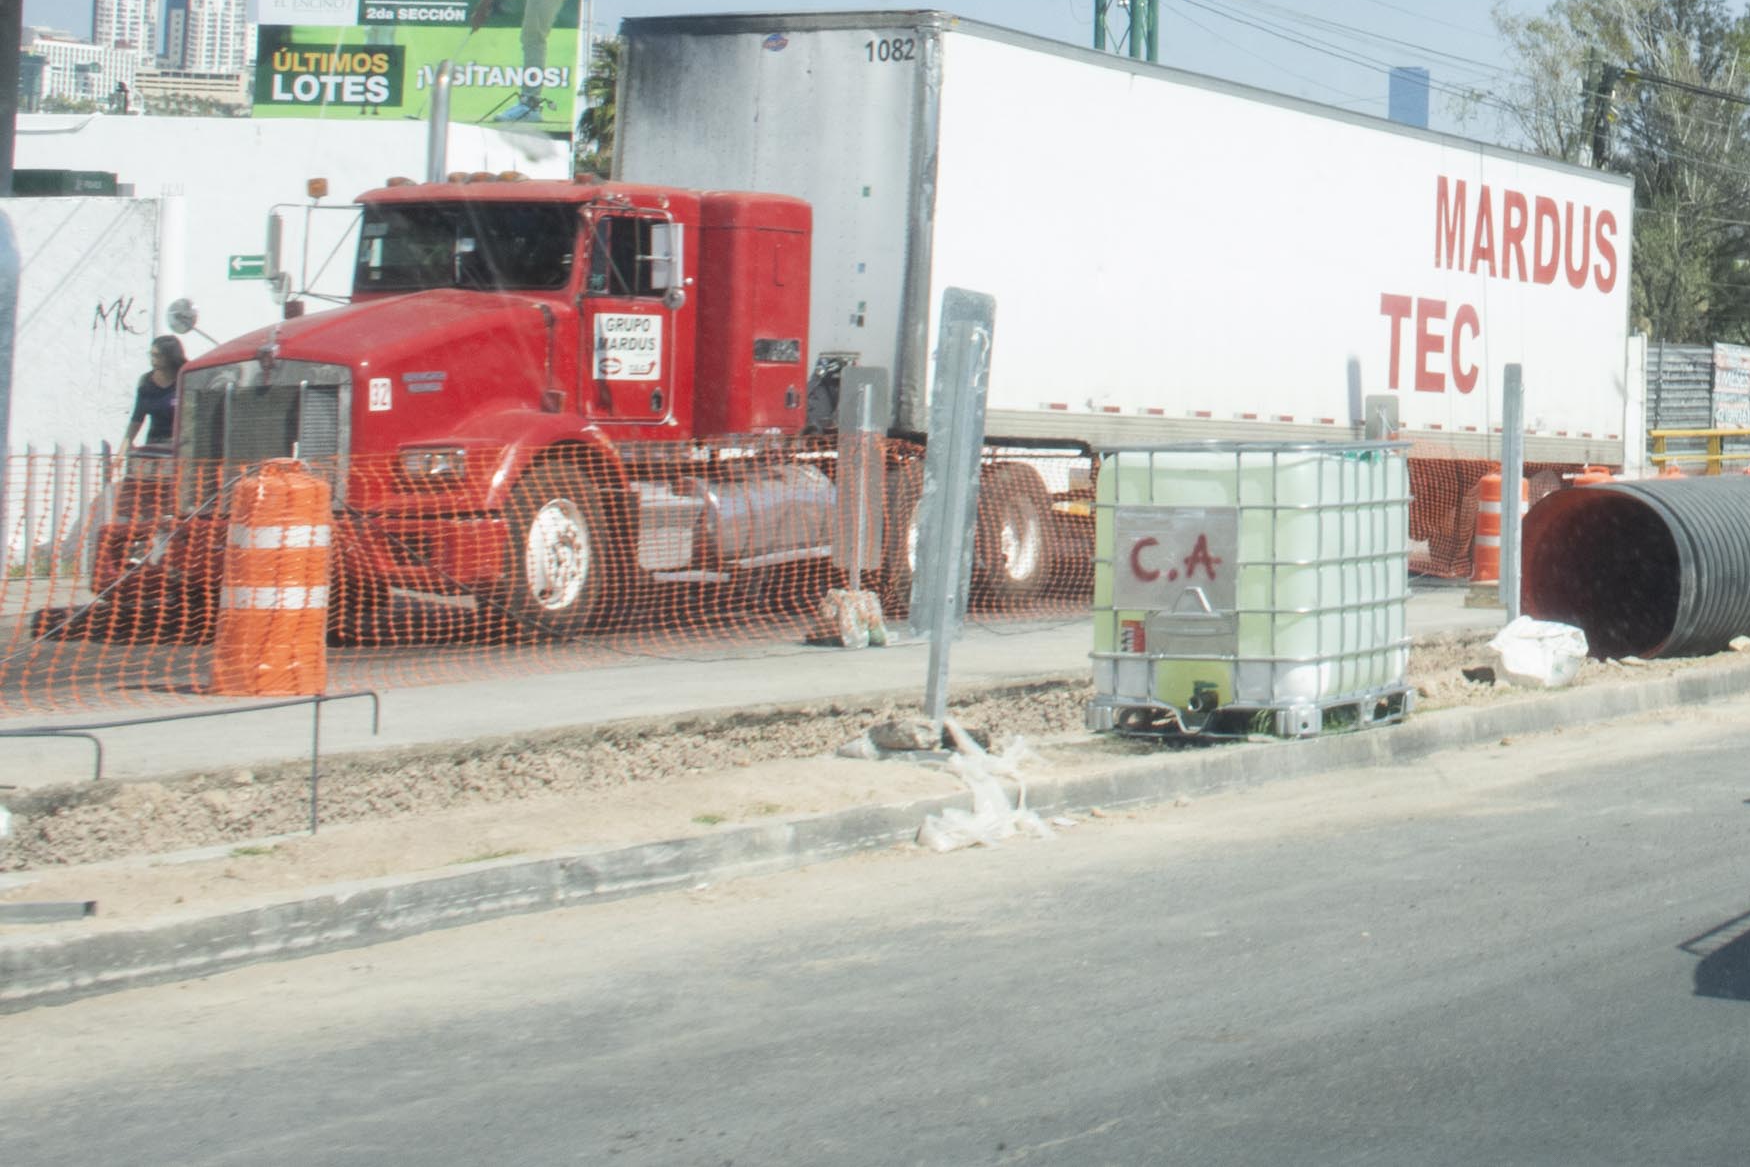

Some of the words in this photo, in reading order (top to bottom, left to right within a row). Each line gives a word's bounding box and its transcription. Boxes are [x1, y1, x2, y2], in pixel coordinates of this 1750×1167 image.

[366, 7, 394, 20] 2da
[397, 6, 466, 21] SECCIÓN
[272, 47, 389, 74] ÚLTIMOS
[865, 38, 916, 63] 1082
[272, 74, 390, 103] LOTES
[416, 61, 569, 90] ¡VSÍTANOS!
[1434, 175, 1618, 294] MARDUS
[606, 318, 651, 332] GRUPO
[598, 337, 656, 351] MARDUS
[1380, 292, 1481, 395] TEC
